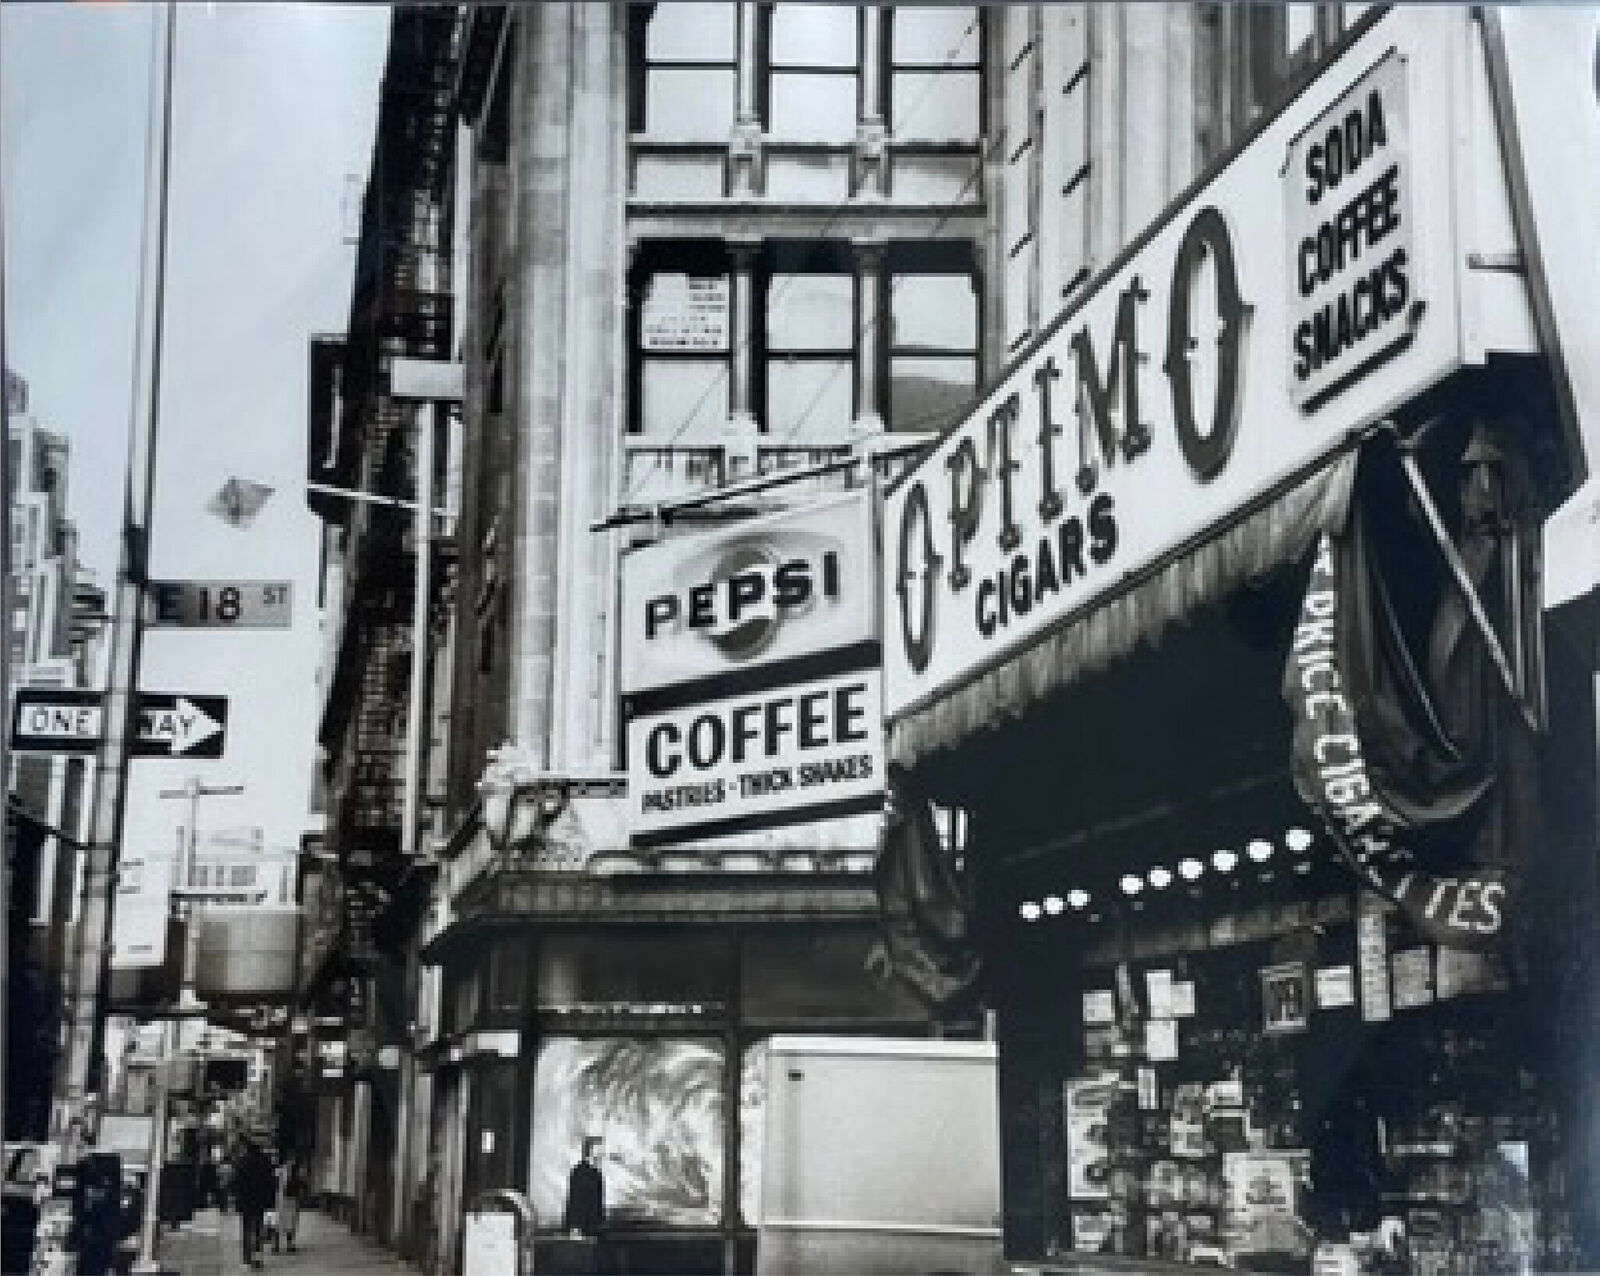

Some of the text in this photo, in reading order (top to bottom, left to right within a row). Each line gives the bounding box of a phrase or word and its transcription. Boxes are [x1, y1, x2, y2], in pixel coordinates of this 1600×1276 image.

[1306, 88, 1387, 204] SODA
[1298, 161, 1402, 297] COFFEE
[1293, 245, 1410, 381] SNACKS
[897, 205, 1255, 674] OPTIMO
[199, 586, 244, 623] 18
[262, 585, 289, 605] ST
[645, 550, 840, 640] PEPSI
[975, 491, 1119, 637] CIGARS
[31, 708, 91, 736] ONE
[646, 682, 869, 779] COFFEE
[641, 778, 726, 814] PASTRIES
[798, 754, 873, 787] SHAKES
